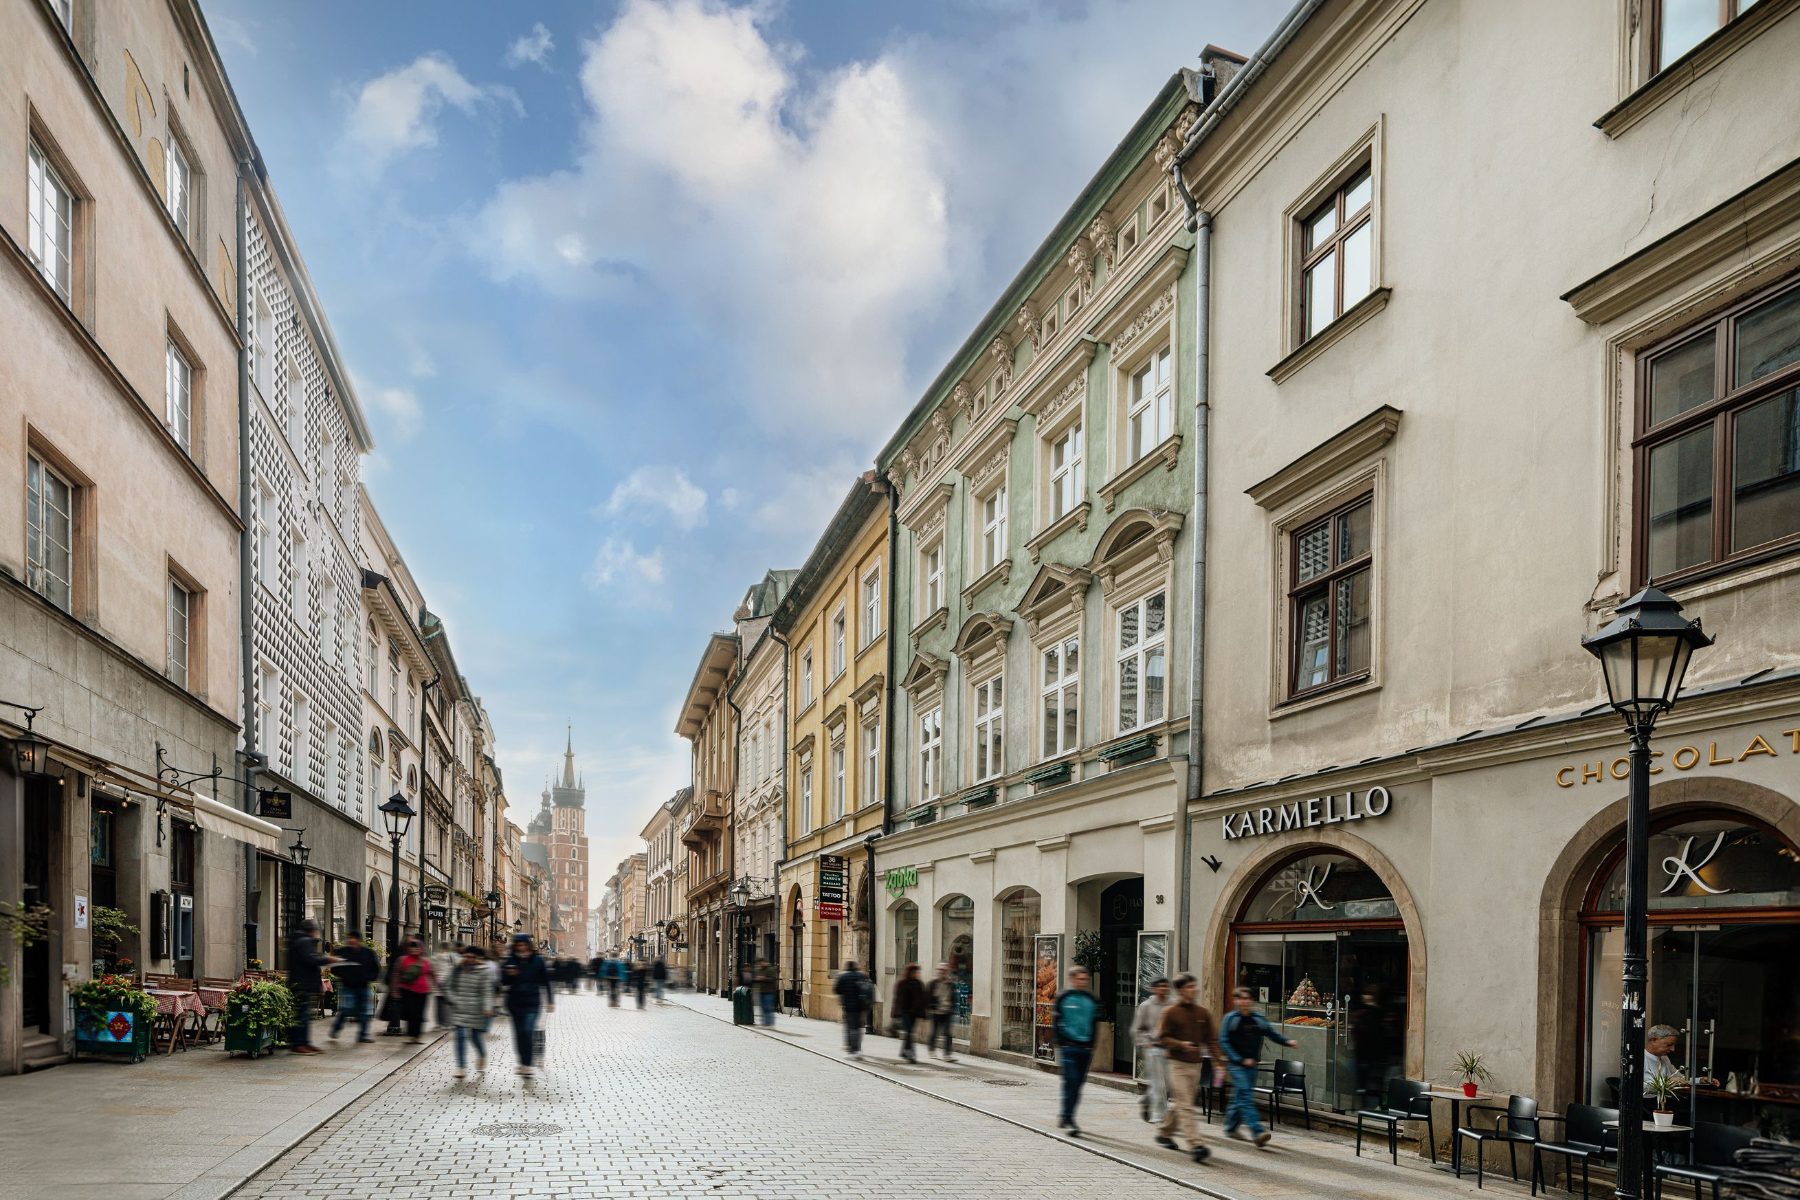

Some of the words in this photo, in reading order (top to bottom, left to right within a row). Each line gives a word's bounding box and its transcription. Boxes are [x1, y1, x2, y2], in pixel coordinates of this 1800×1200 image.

[1222, 786, 1392, 840] KARMELLO
[1296, 862, 1335, 910] K
[1660, 831, 1731, 894] K
[1155, 895, 1164, 904] 38
